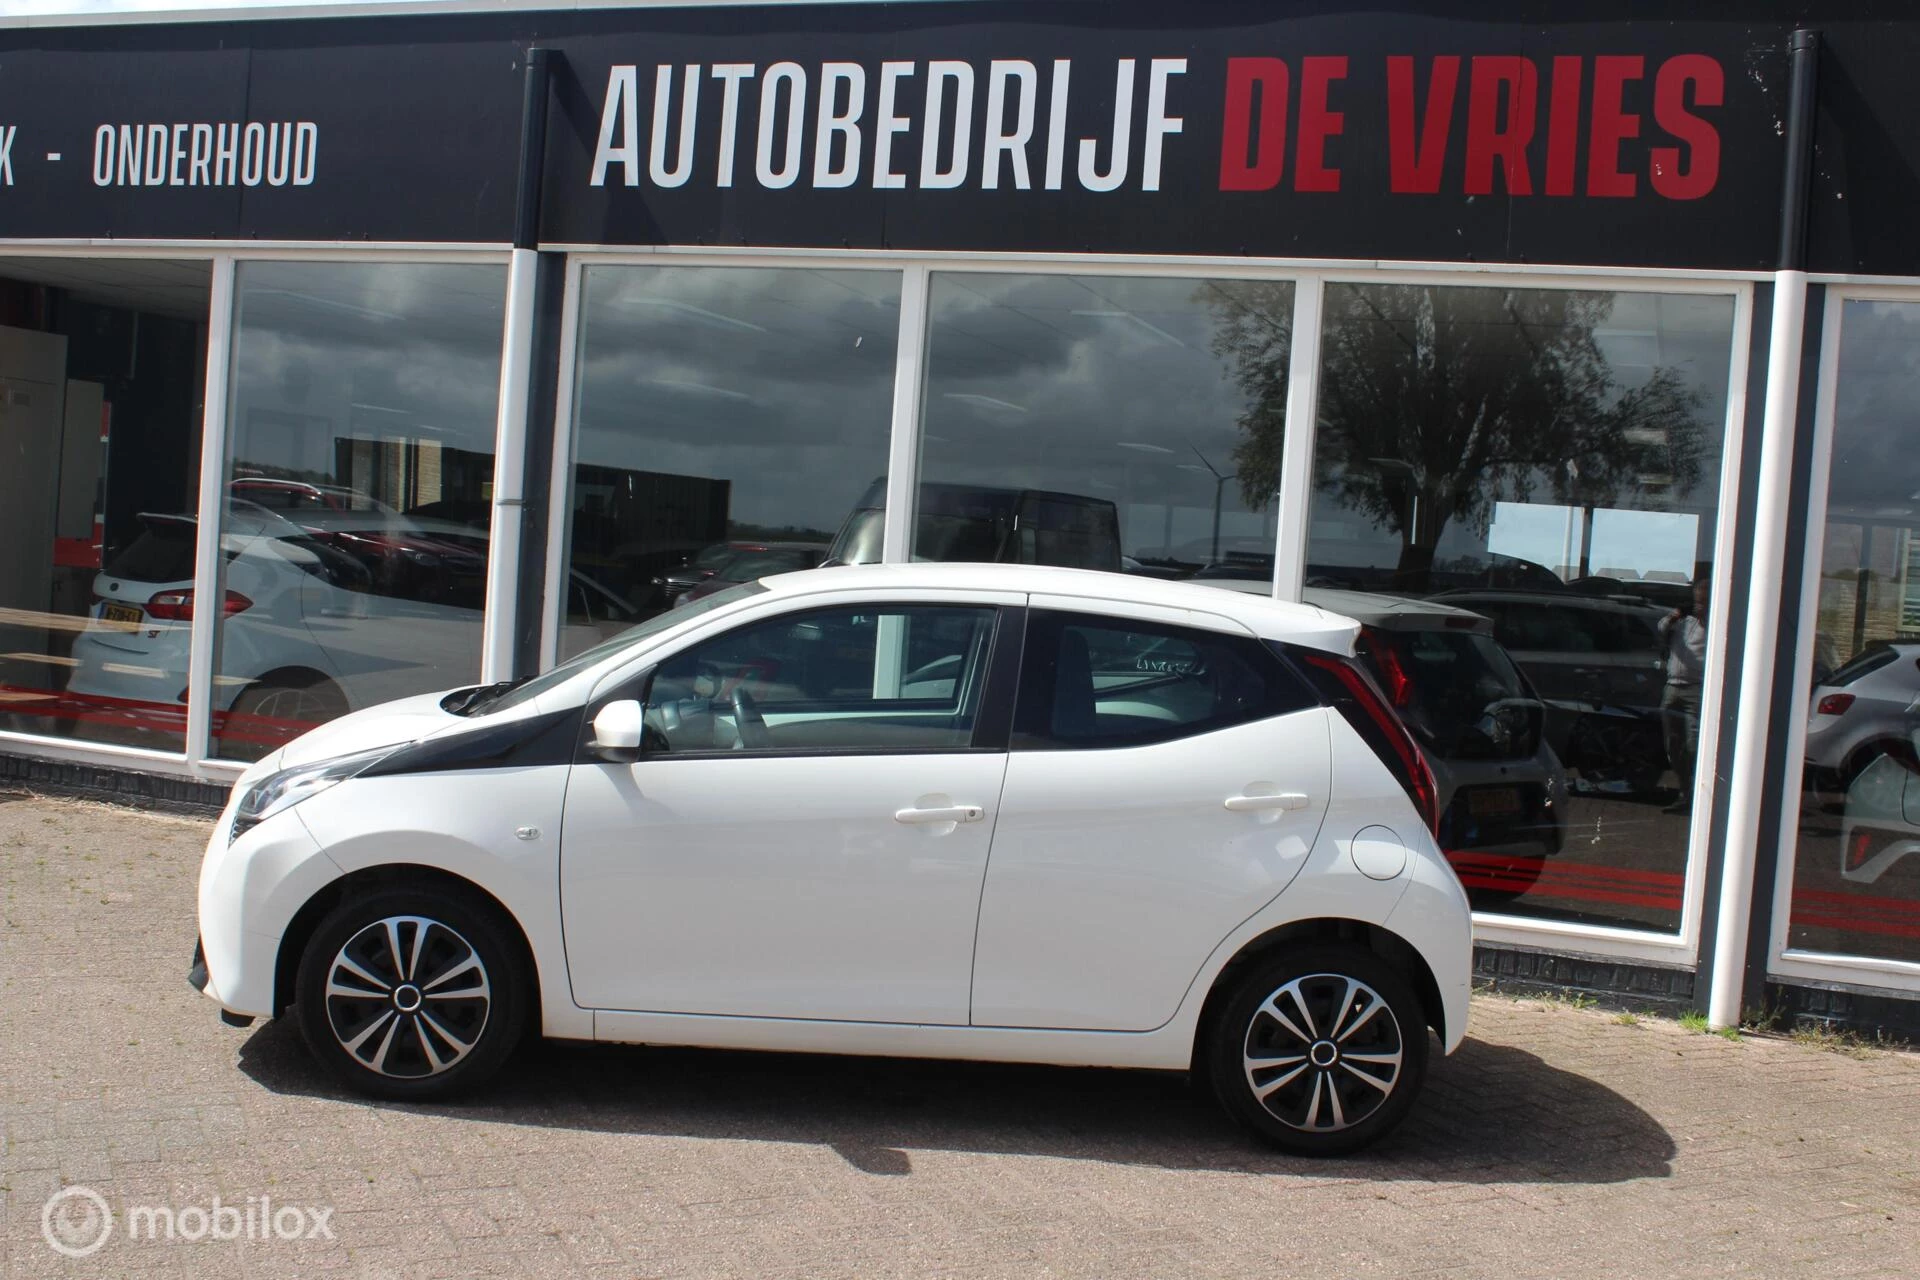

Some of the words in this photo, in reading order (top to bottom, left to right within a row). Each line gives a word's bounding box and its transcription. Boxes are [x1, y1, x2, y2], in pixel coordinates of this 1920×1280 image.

[93, 121, 318, 187] ONDERHOUD
[591, 58, 1188, 192] AUTOBEDRIJF
[1219, 56, 1349, 193] DE
[1387, 54, 1725, 200] VRIES
